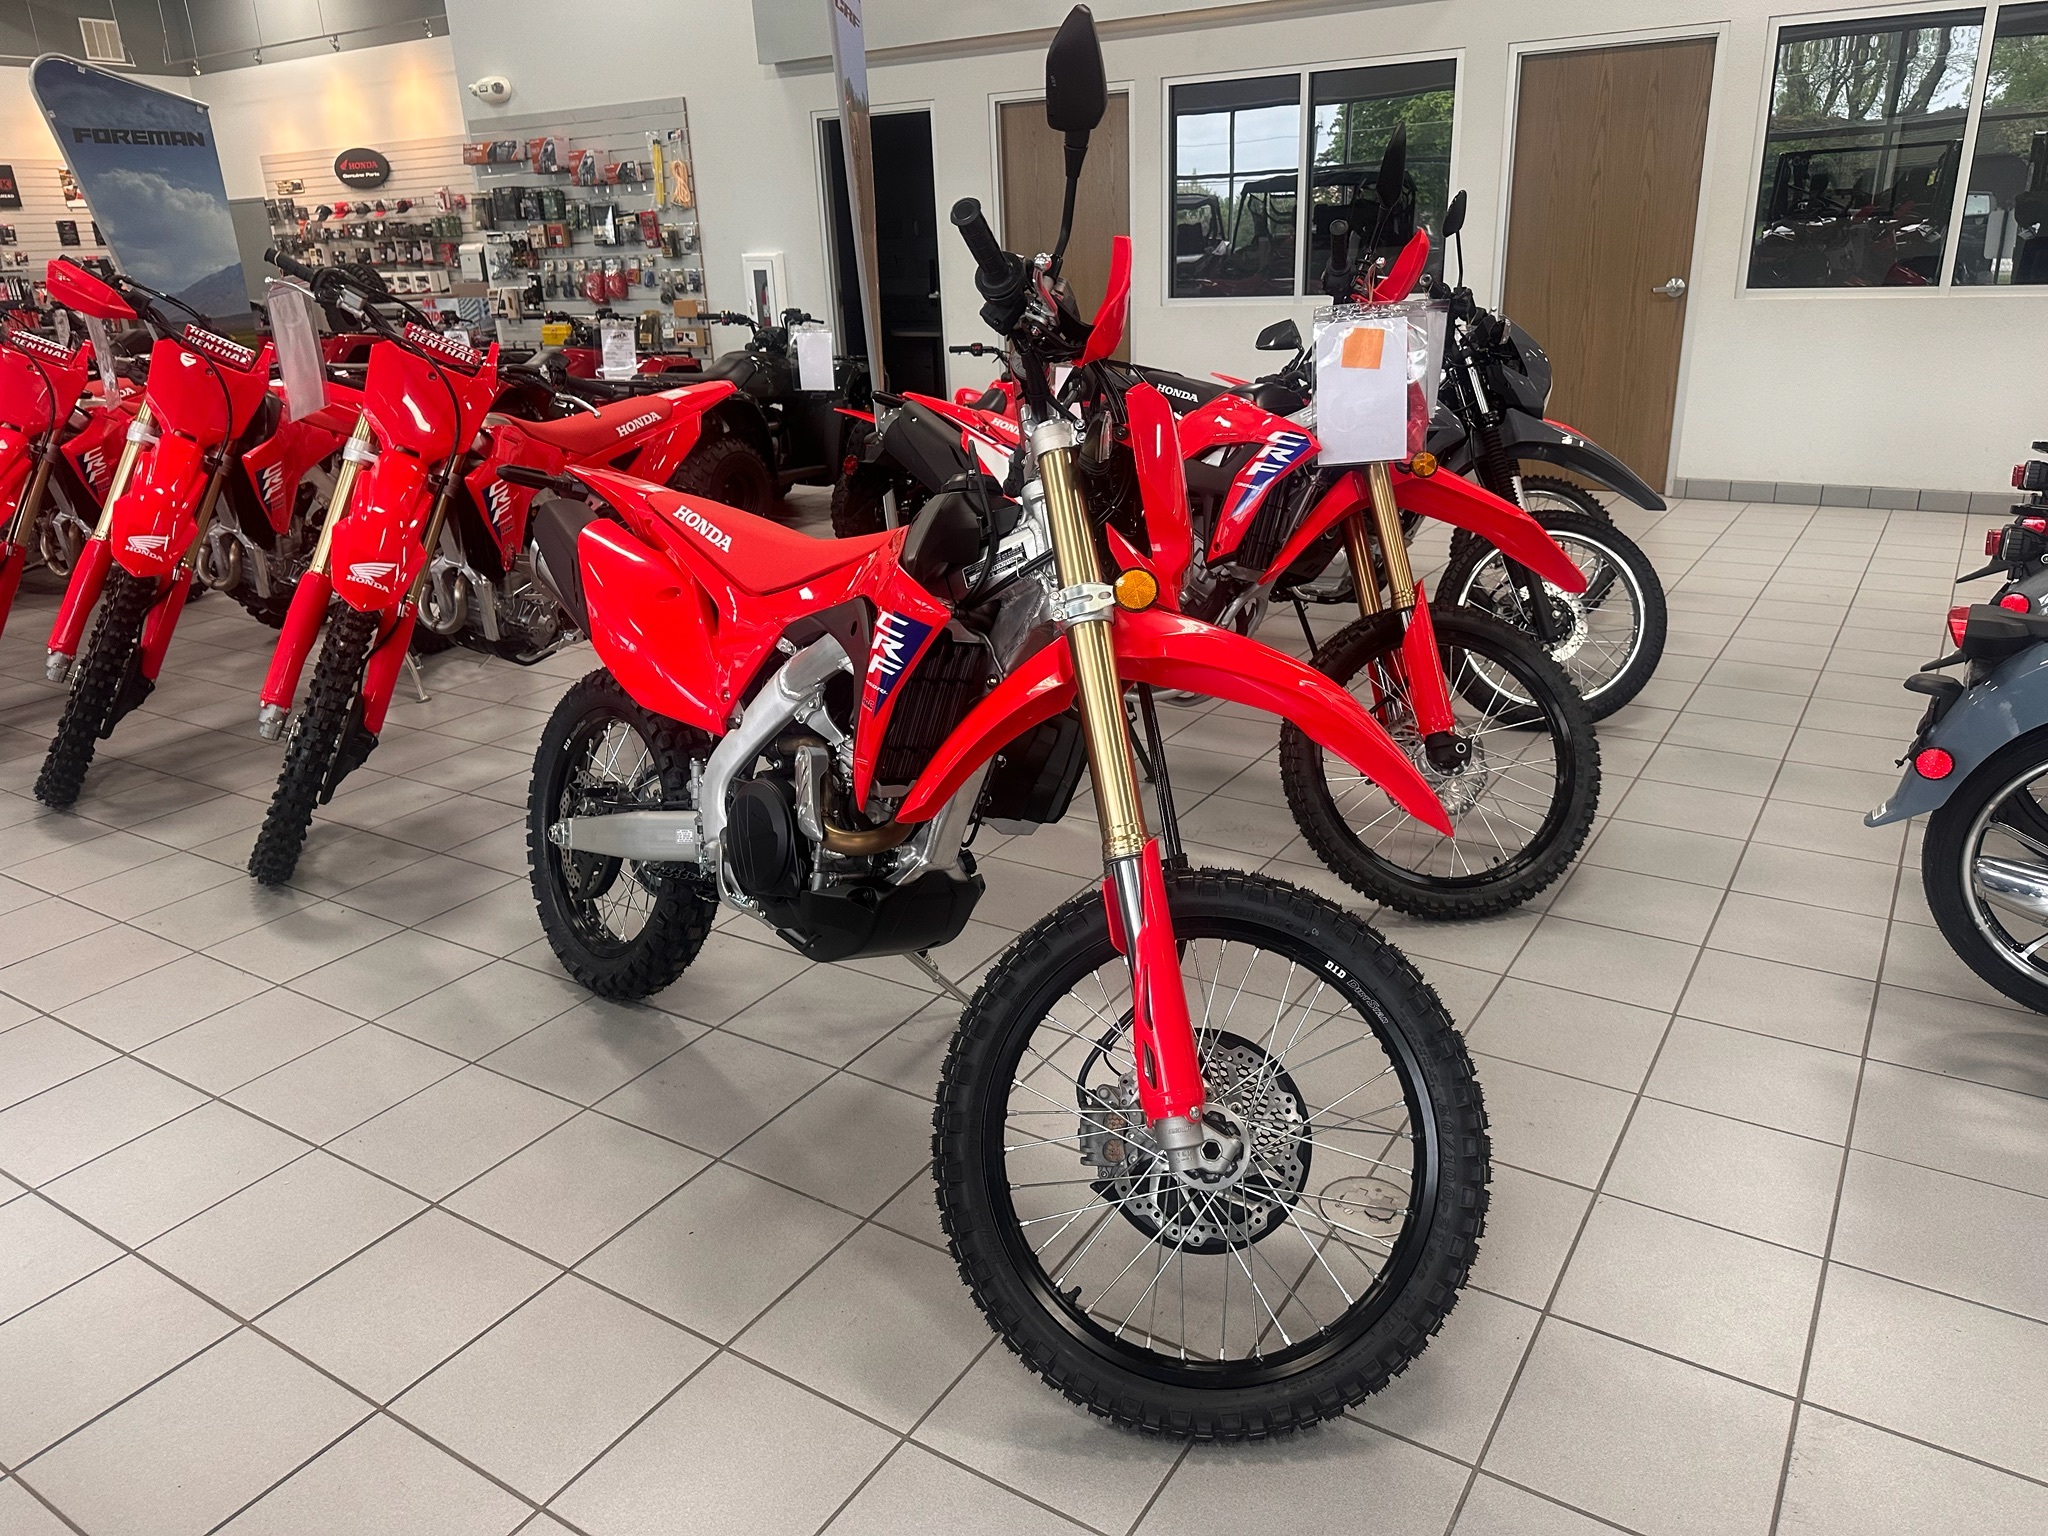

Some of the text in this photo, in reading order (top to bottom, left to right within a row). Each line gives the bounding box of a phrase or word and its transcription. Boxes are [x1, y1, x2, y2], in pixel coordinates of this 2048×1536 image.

[72, 127, 206, 147] FOREMAN
[348, 161, 379, 170] HONDA
[12, 336, 69, 361] RENTHAL
[408, 331, 474, 365] RENTHAL
[1156, 383, 1199, 403] HONDA
[615, 411, 662, 438] HONDA
[991, 416, 1020, 436] HON
[83, 446, 107, 484] CRF
[1245, 430, 1307, 476] CRF
[262, 460, 283, 501] CRF
[488, 479, 511, 524] CRF
[672, 504, 733, 554] HONDA
[124, 544, 164, 563] HONDA
[345, 574, 390, 594] HONDA
[867, 610, 909, 676] CRF
